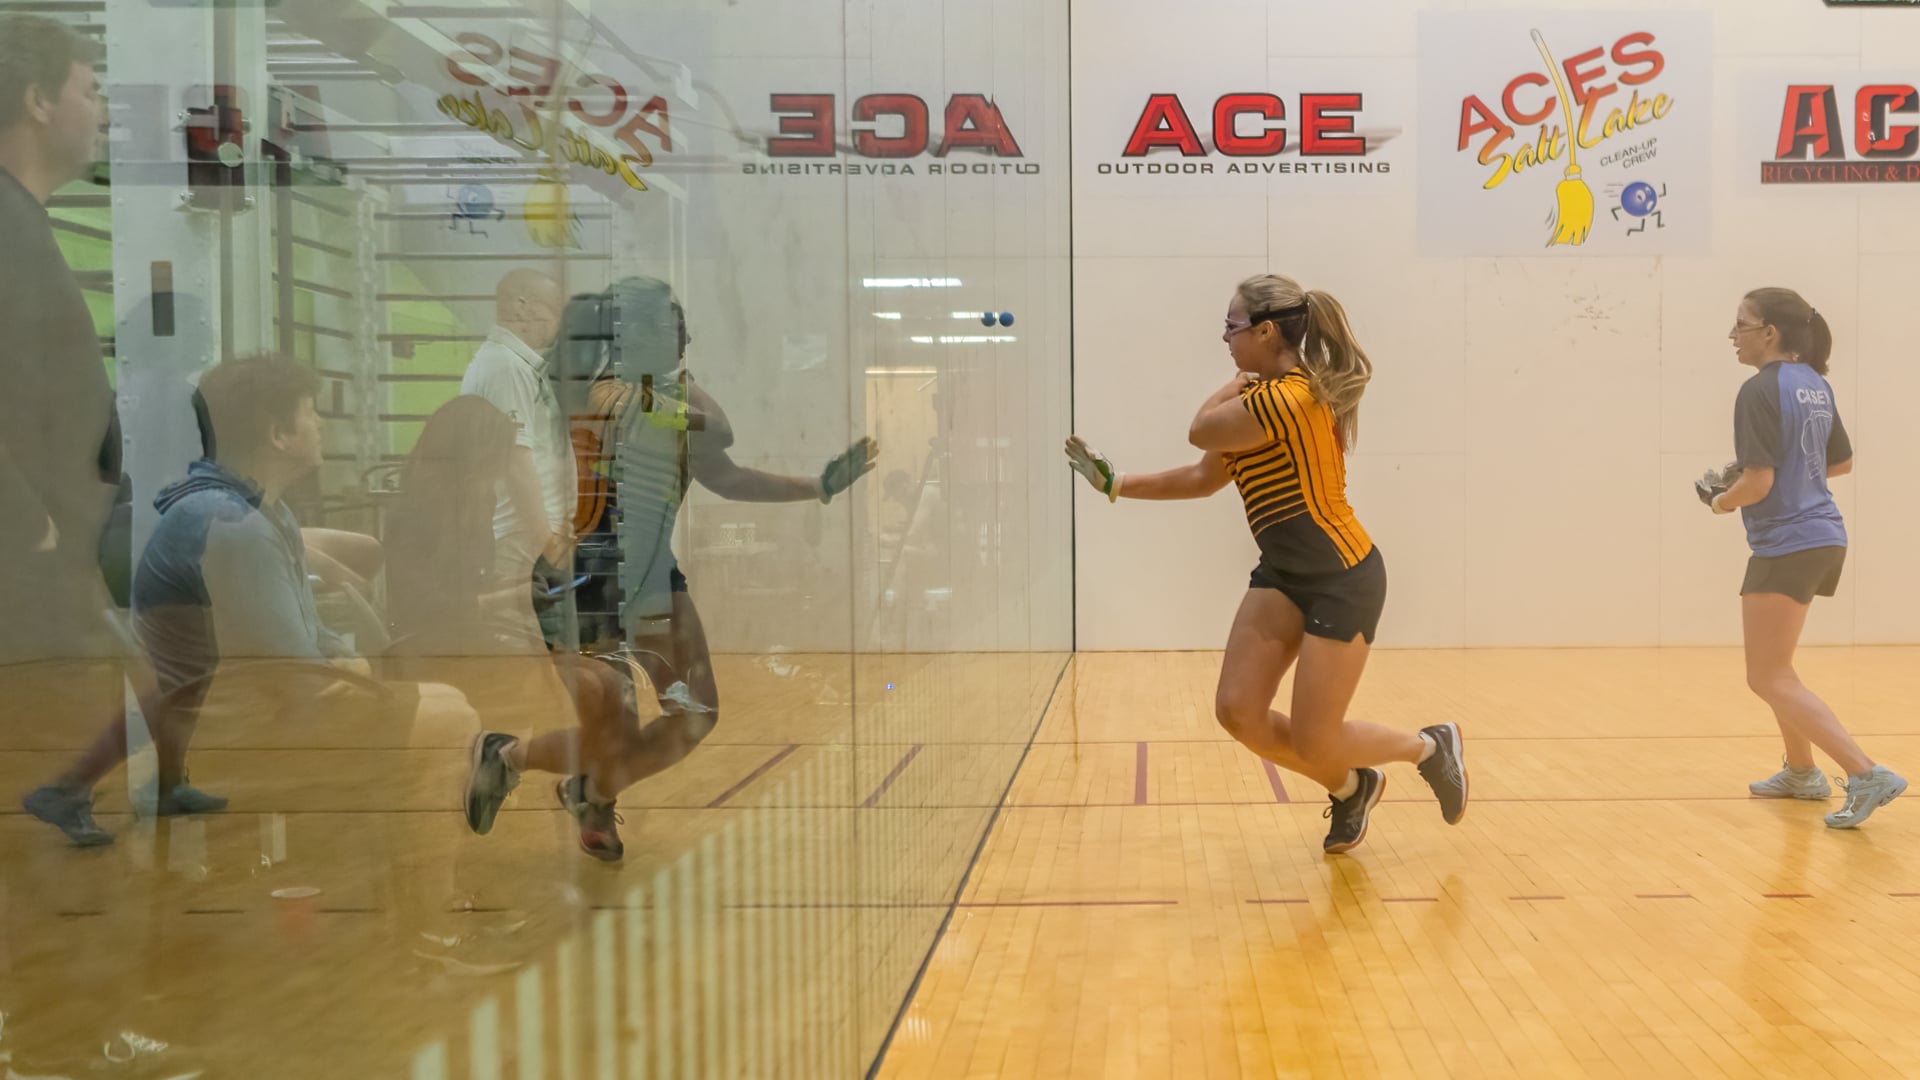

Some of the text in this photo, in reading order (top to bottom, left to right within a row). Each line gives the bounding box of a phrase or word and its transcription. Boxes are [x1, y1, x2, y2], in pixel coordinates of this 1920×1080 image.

[1457, 32, 1665, 152] ACES
[1121, 93, 1366, 157] ACE
[1477, 87, 1674, 189] Salt Lake
[1600, 138, 1657, 167] CLEAN-UP
[1623, 147, 1657, 169] CREW
[1097, 162, 1391, 175] OUTDOOR ADVERTISING
[1762, 164, 1879, 181] RECYCLING
[1884, 164, 1899, 181] &
